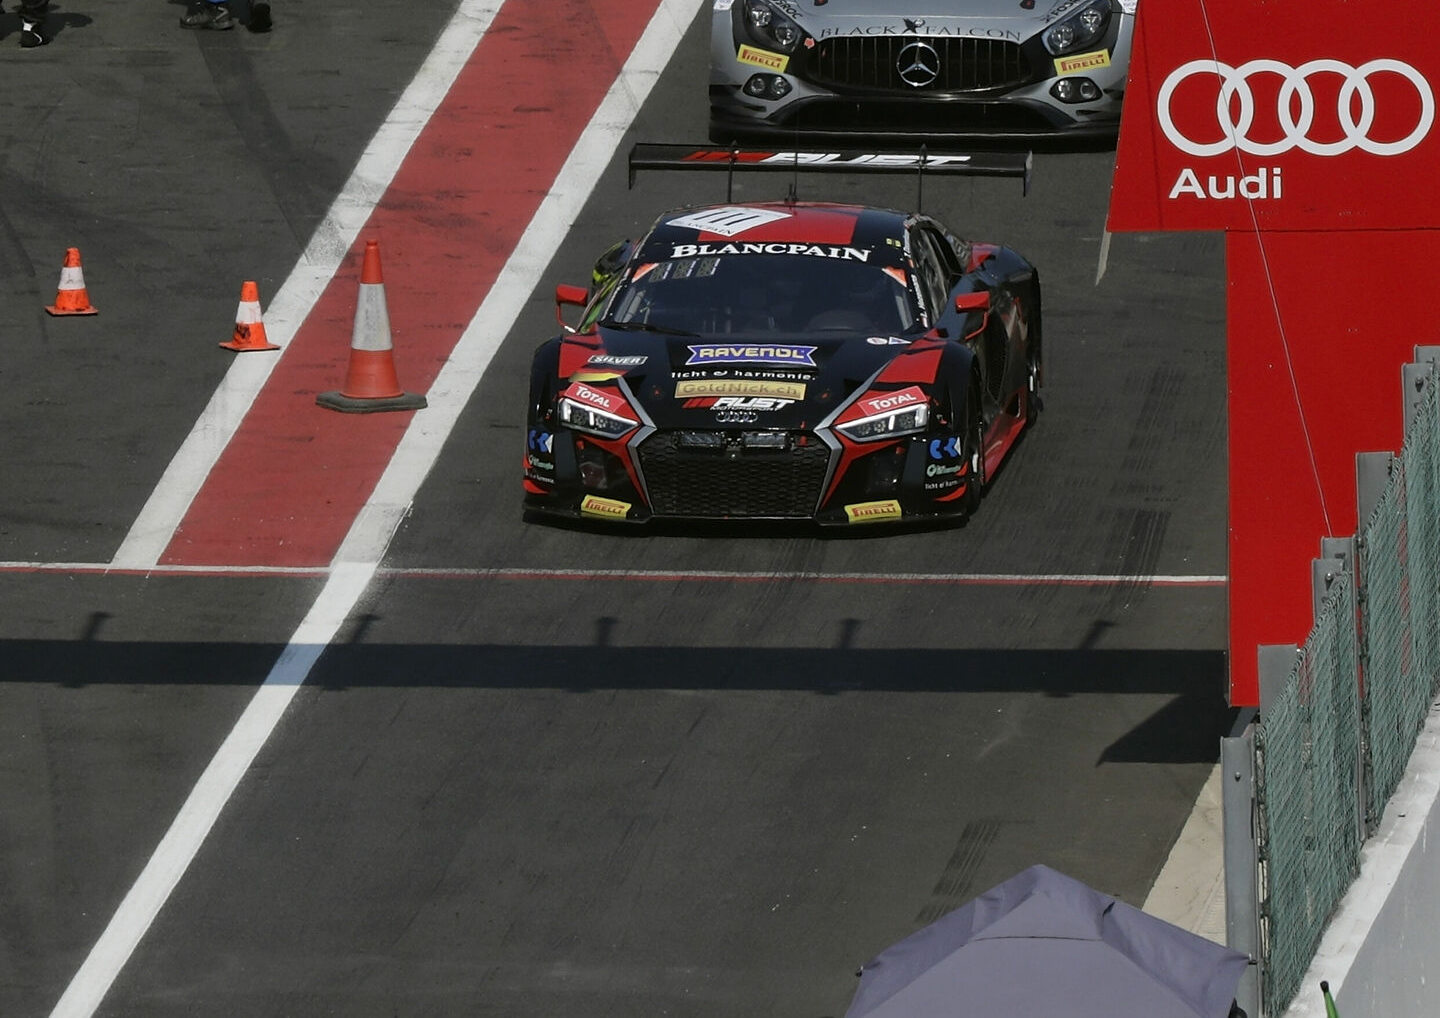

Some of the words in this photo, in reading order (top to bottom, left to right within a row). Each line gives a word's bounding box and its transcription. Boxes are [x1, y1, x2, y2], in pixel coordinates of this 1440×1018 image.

[820, 25, 897, 38] BLACK
[926, 27, 1021, 41] FALCON
[741, 48, 783, 69] PIRELLI
[1060, 54, 1105, 72] PIRELLI
[1168, 167, 1282, 199] Audi
[670, 242, 873, 263] BLANCPAIN
[594, 355, 643, 365] SILVER
[699, 347, 805, 359] RAVENOL
[671, 370, 707, 379] licht
[575, 386, 611, 408] TOTAL
[683, 383, 798, 395] GoldNick.ch
[868, 392, 917, 410] TOTAL
[585, 498, 623, 515] PIRELLI
[851, 503, 896, 518] PIRELLI
